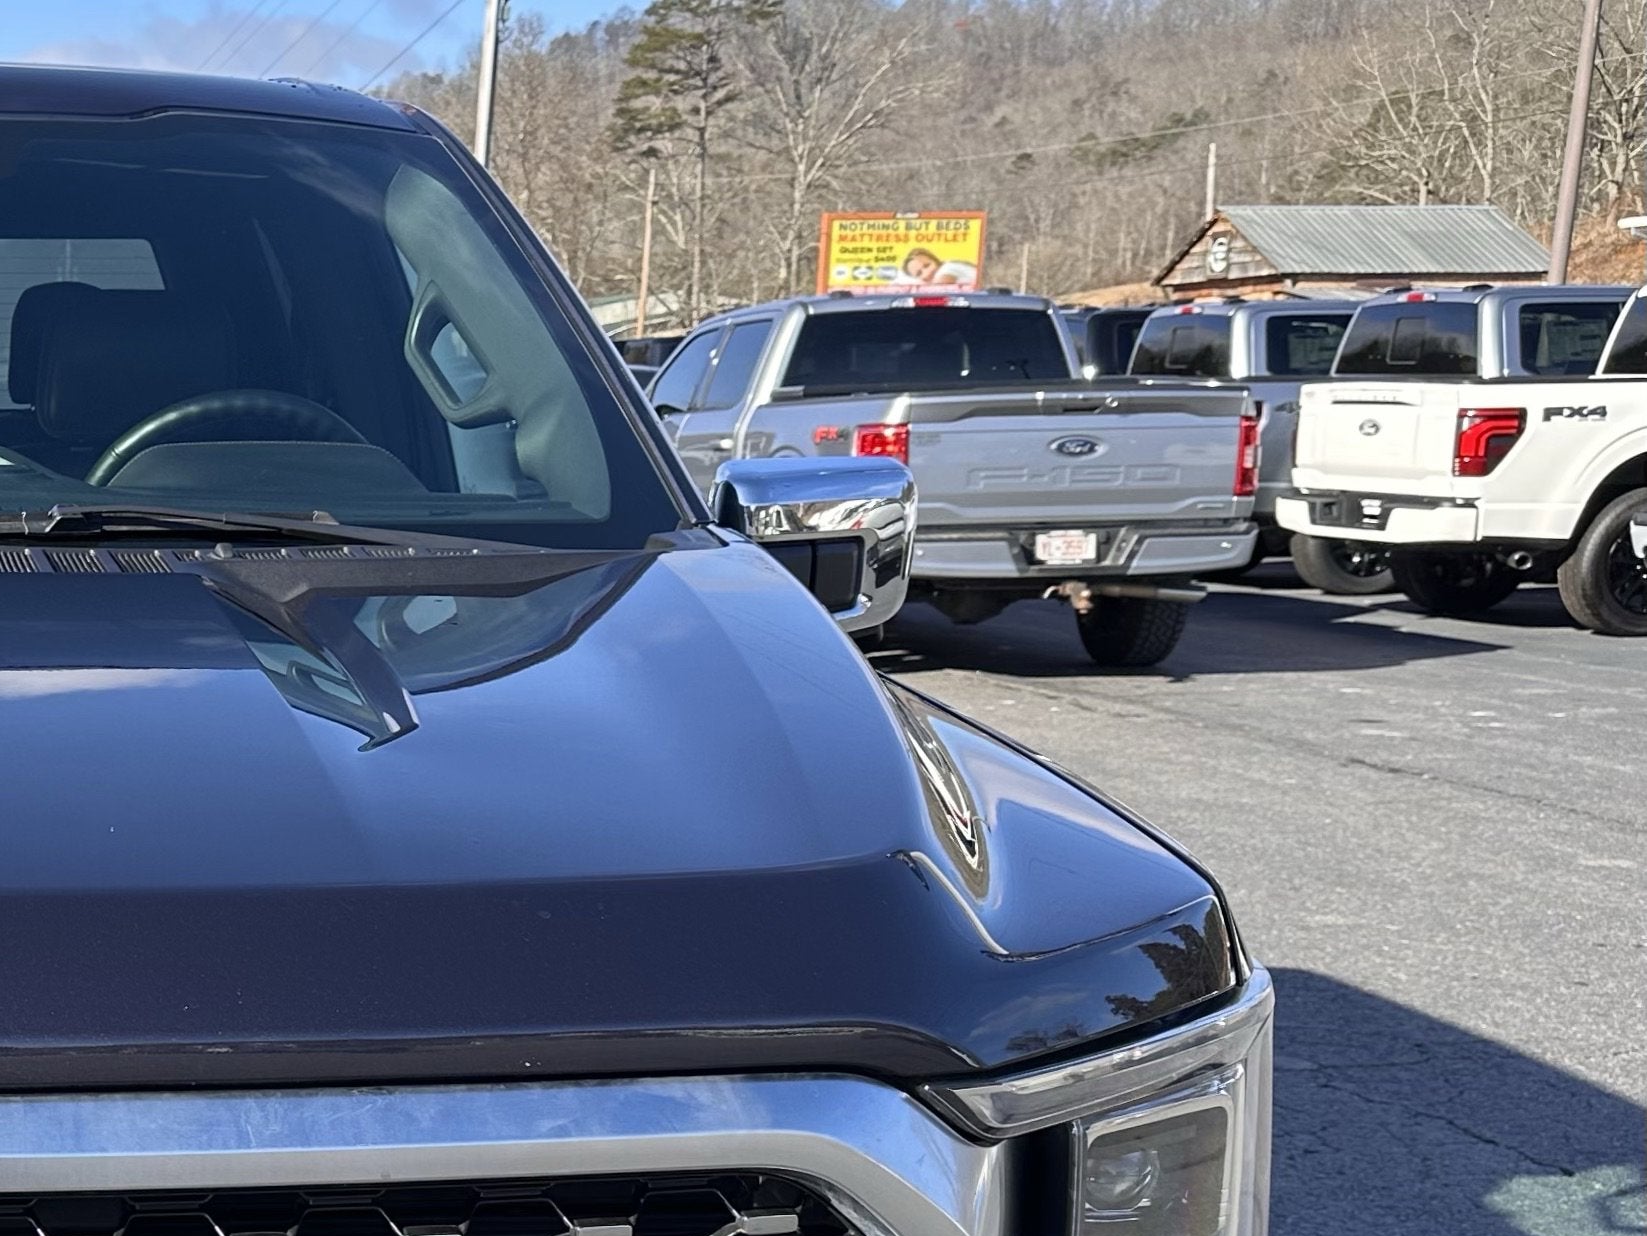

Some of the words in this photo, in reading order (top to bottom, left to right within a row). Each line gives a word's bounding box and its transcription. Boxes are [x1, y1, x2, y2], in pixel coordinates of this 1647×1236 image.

[838, 221, 900, 232] NOTHING
[905, 221, 931, 232] BUT
[936, 220, 970, 232] BEDS
[837, 232, 910, 243] MATTRESS
[915, 232, 969, 243] OUTLET
[1542, 405, 1607, 422] FX4
[966, 463, 1181, 490] F-150
